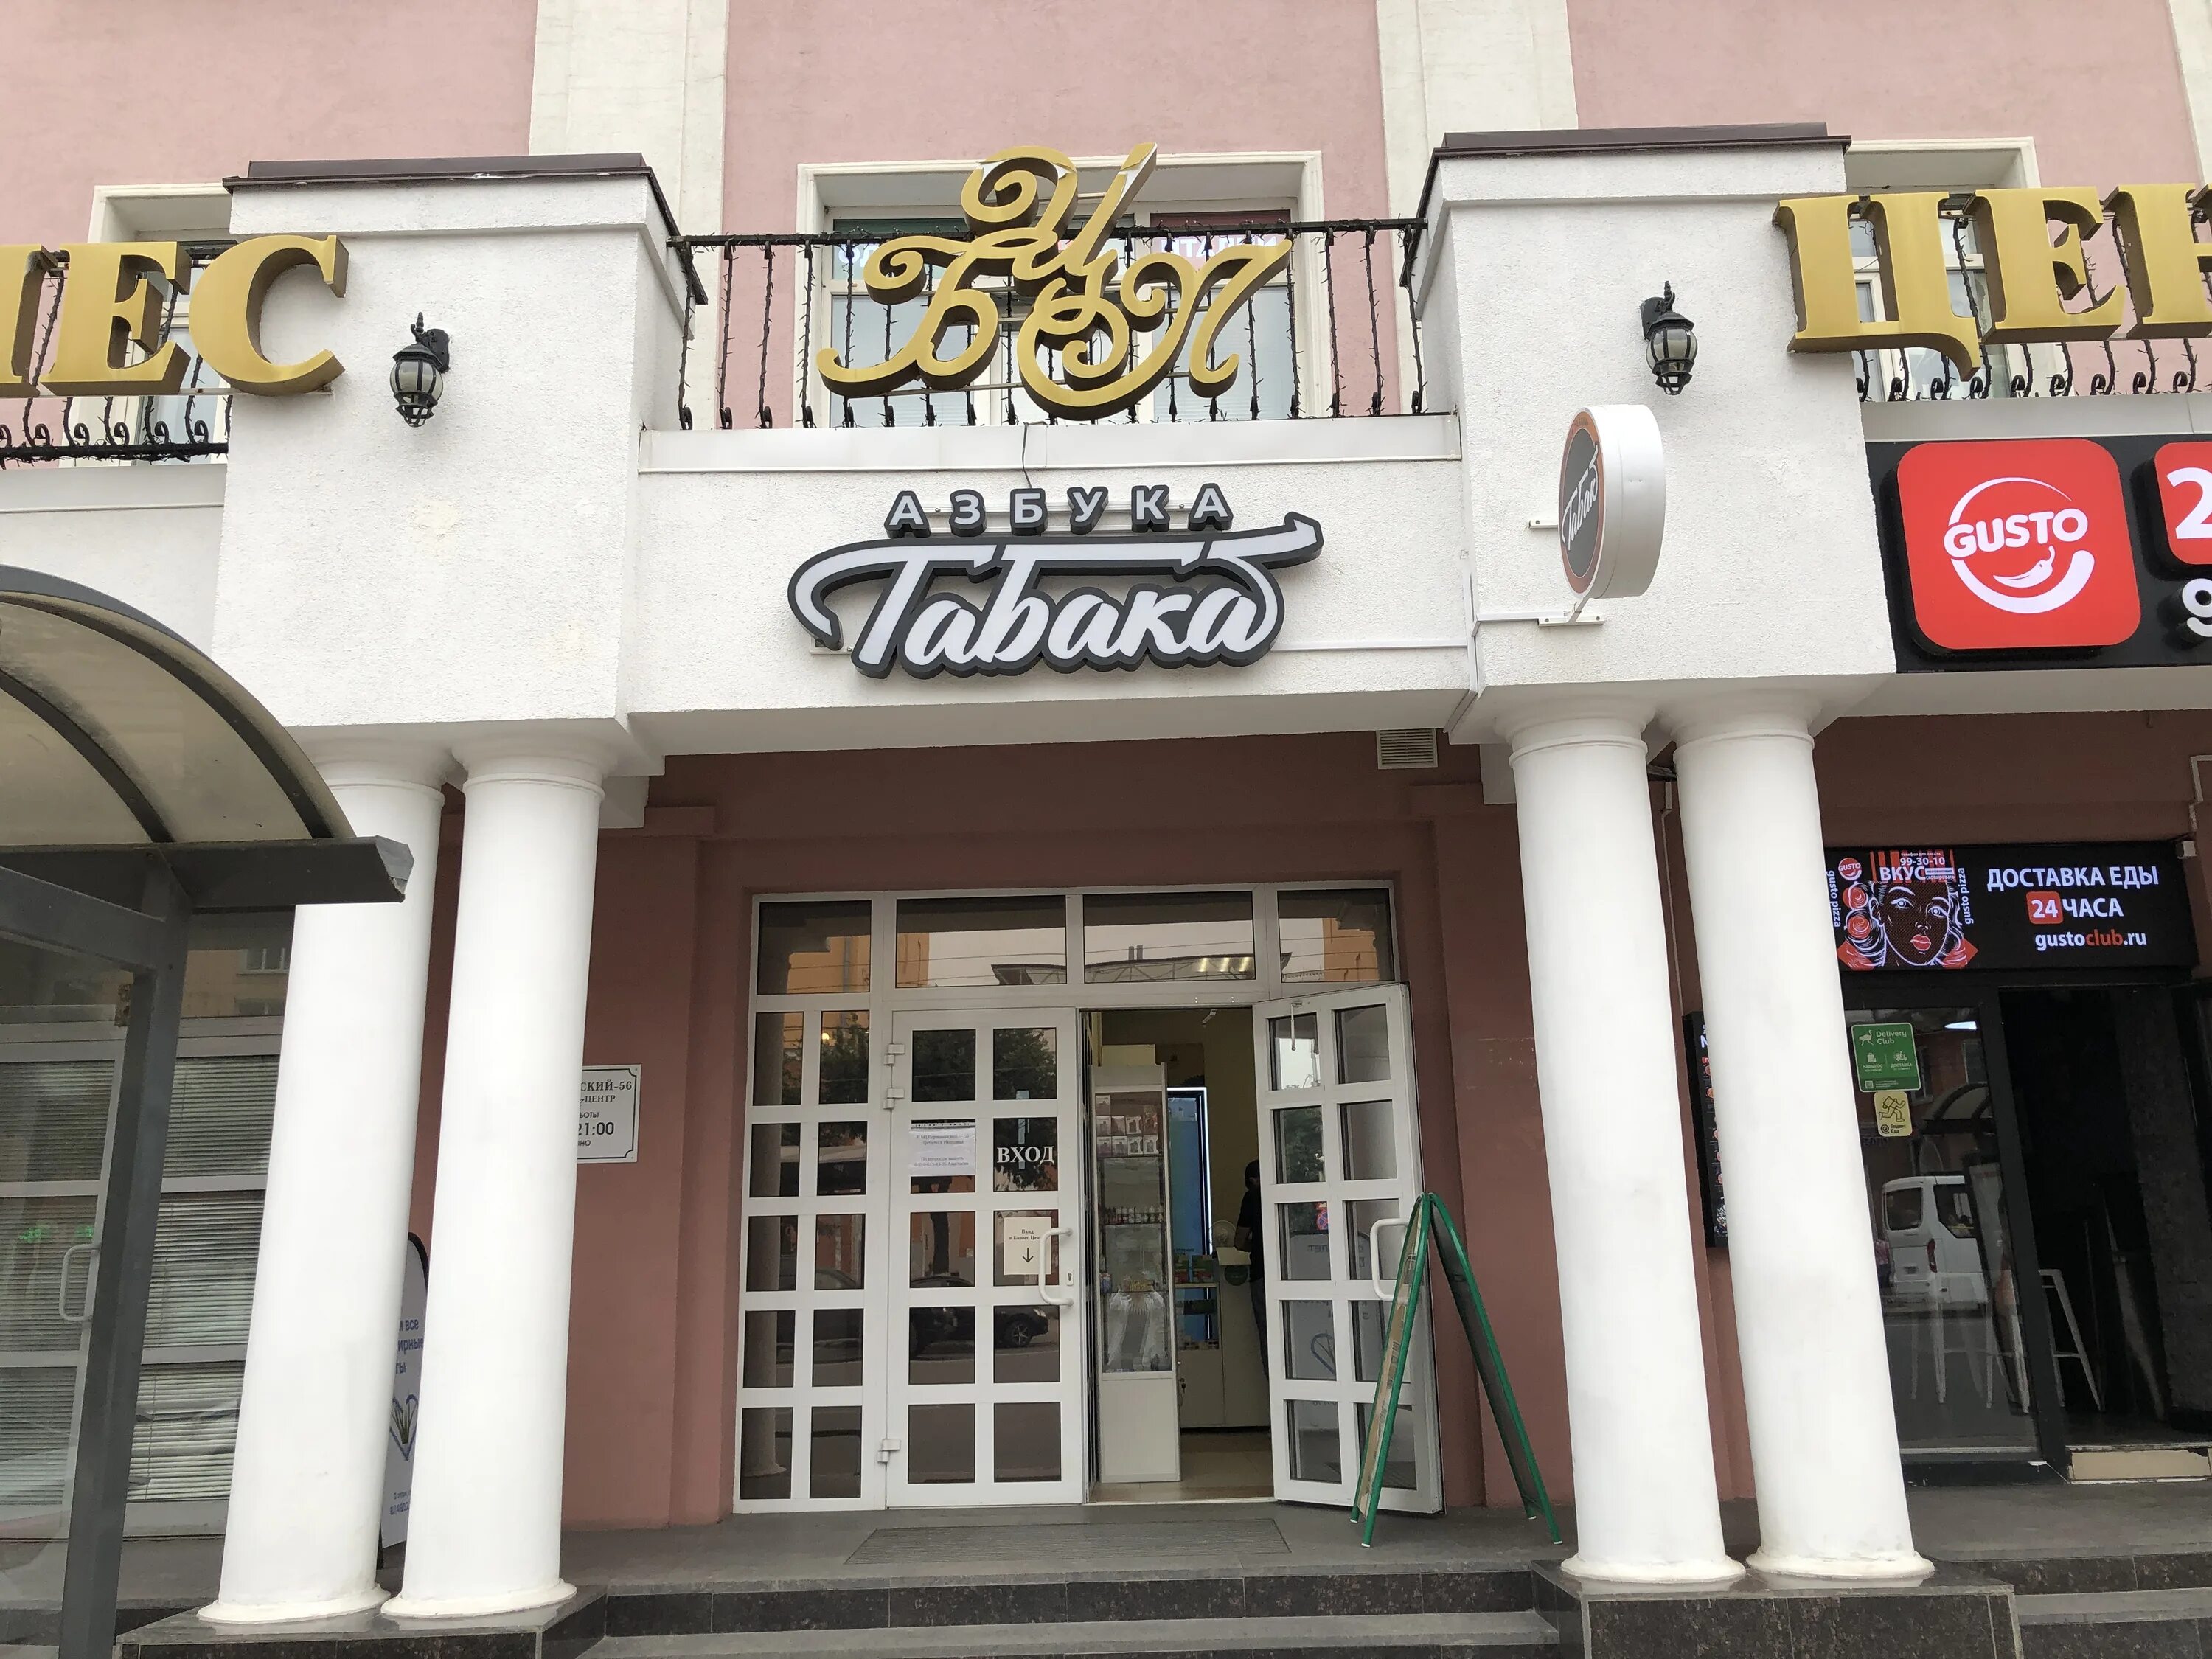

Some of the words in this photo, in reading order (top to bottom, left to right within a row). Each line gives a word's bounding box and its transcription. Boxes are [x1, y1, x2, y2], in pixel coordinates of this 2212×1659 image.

[0, 234, 348, 394] ЕС
[885, 483, 1234, 538] АЗБУКА
[1944, 507, 2089, 559] GUSTO
[787, 512, 1324, 679] Табака
[1838, 863, 1862, 871] GUSTO
[1879, 866, 1927, 881] ВКУС
[1899, 857, 1945, 866] 99-30-10
[1826, 869, 1838, 899] gusto
[1958, 867, 1970, 894] pizza
[1986, 867, 2107, 892] ДОСТАВКА
[2108, 866, 2160, 889] ЕДЫ
[1830, 901, 1842, 928] pizza
[1961, 895, 1974, 925] gusto
[2031, 899, 2059, 918] 24
[2062, 897, 2124, 917] ЧАСА
[2034, 929, 2148, 951] gustoclub.ru
[1876, 1030, 1907, 1038] Delivery
[996, 1146, 1055, 1166] ВХОД
